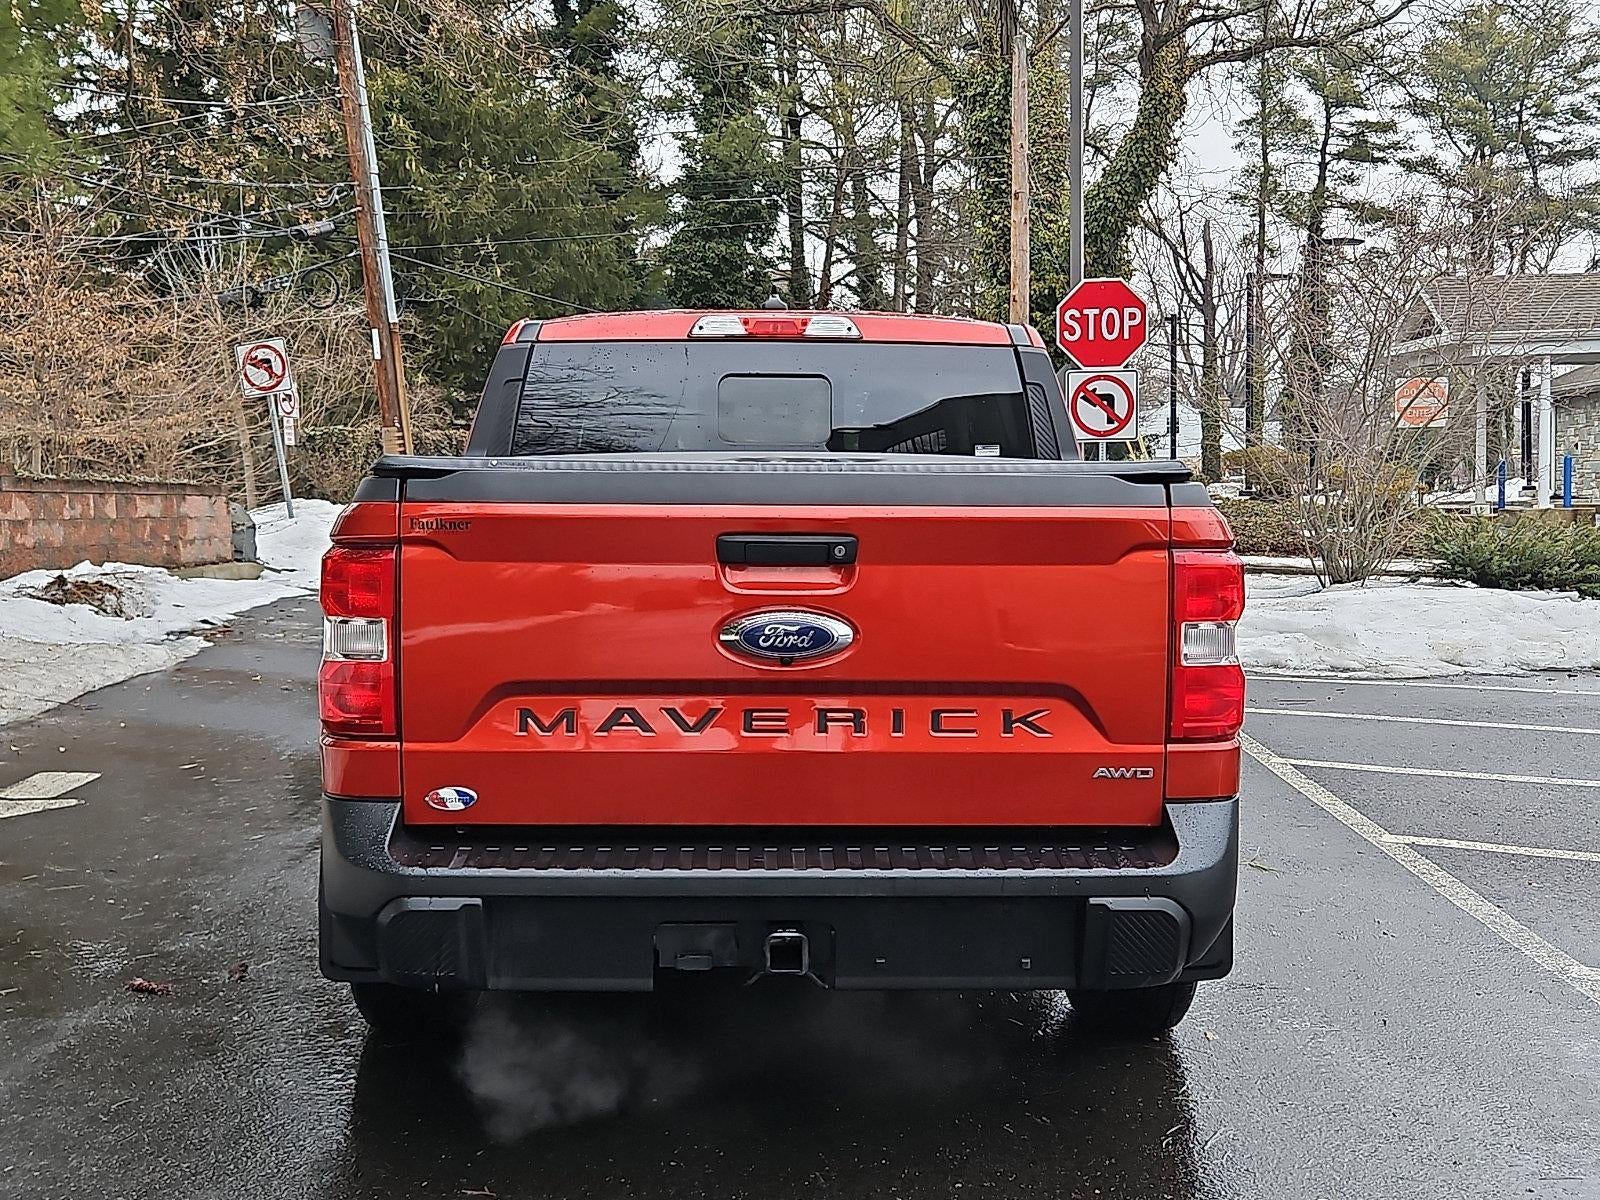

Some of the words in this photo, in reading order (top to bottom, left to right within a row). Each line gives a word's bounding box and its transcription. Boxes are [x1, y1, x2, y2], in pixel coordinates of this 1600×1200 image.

[1062, 307, 1143, 342] STOP
[1403, 388, 1417, 396] DO
[409, 517, 471, 530] Faulkner
[758, 624, 814, 648] Ford
[514, 706, 1053, 738] MAVERICK
[1092, 767, 1154, 779] AWD
